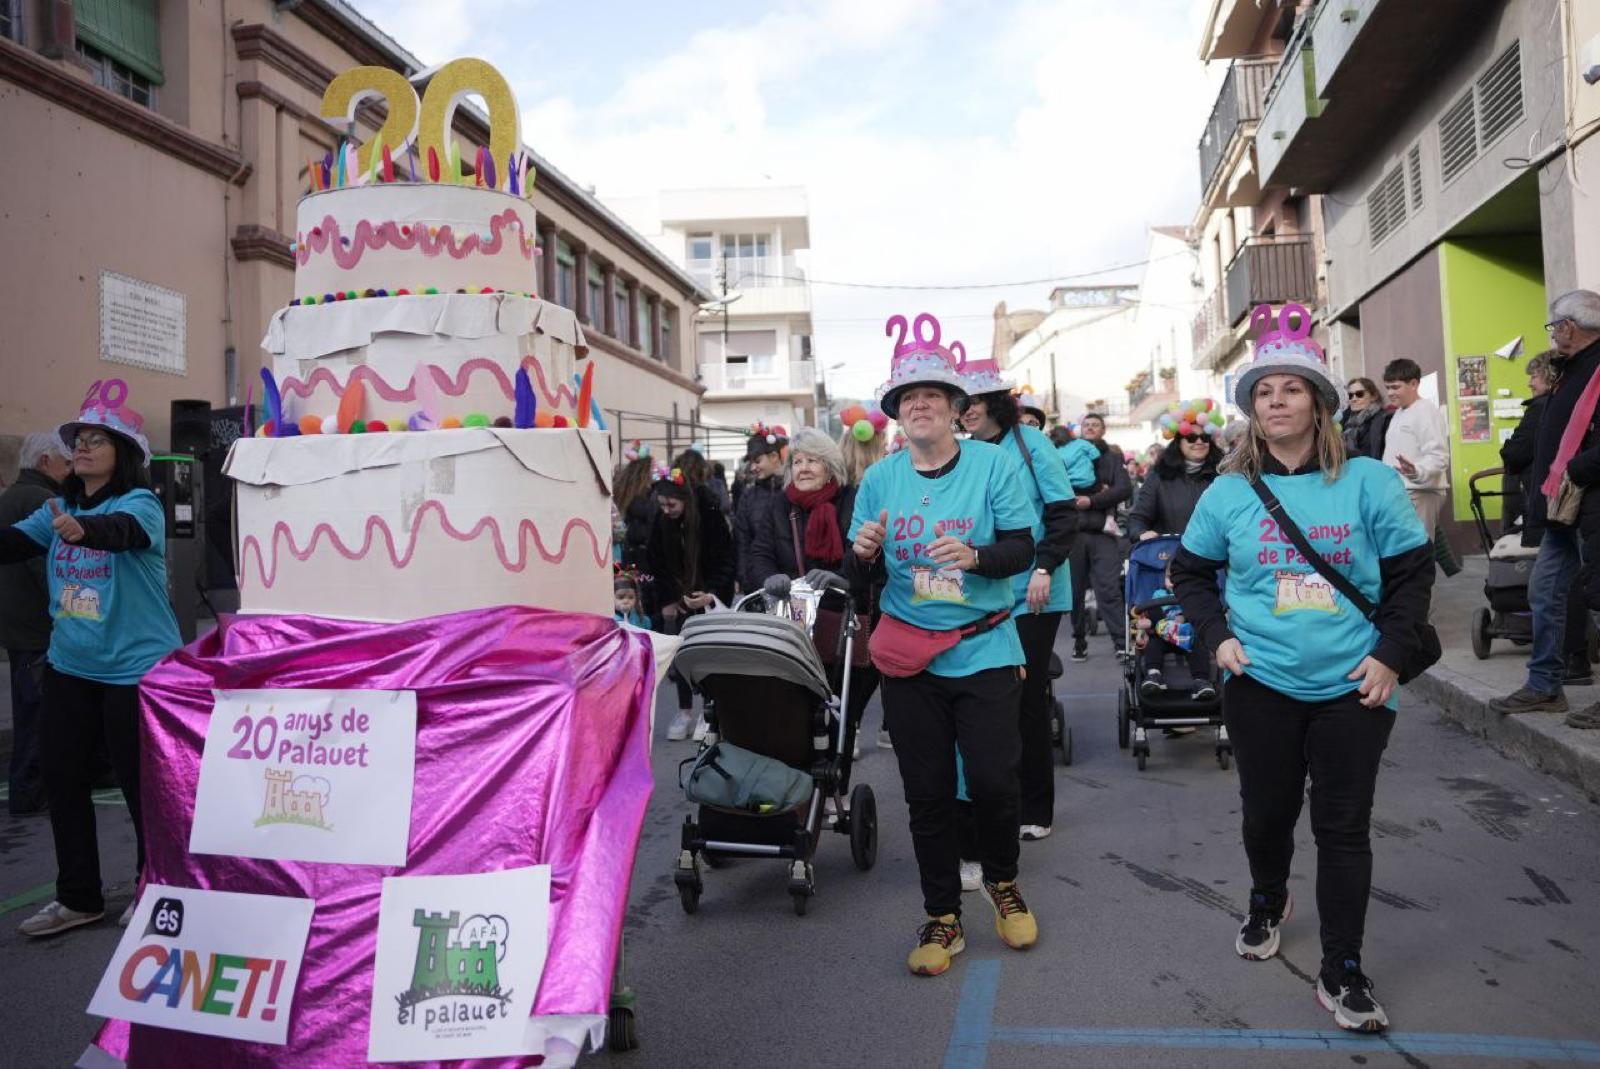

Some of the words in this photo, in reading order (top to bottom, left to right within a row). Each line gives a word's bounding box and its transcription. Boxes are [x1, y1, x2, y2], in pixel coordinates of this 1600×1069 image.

[320, 57, 519, 188] 20
[886, 312, 941, 358] 20
[893, 515, 925, 541] 20
[1308, 523, 1351, 544] anys
[895, 545, 909, 561] de
[1258, 546, 1279, 565] de
[1285, 547, 1351, 565] Pauet
[227, 715, 278, 760] 20
[284, 712, 333, 740] anys
[340, 707, 369, 733] de
[278, 739, 369, 767] Palauet
[155, 902, 180, 932] és
[470, 925, 498, 939] AFA
[119, 944, 287, 1022] CANET!
[397, 1004, 416, 1025] el
[424, 1000, 508, 1031] palauet
